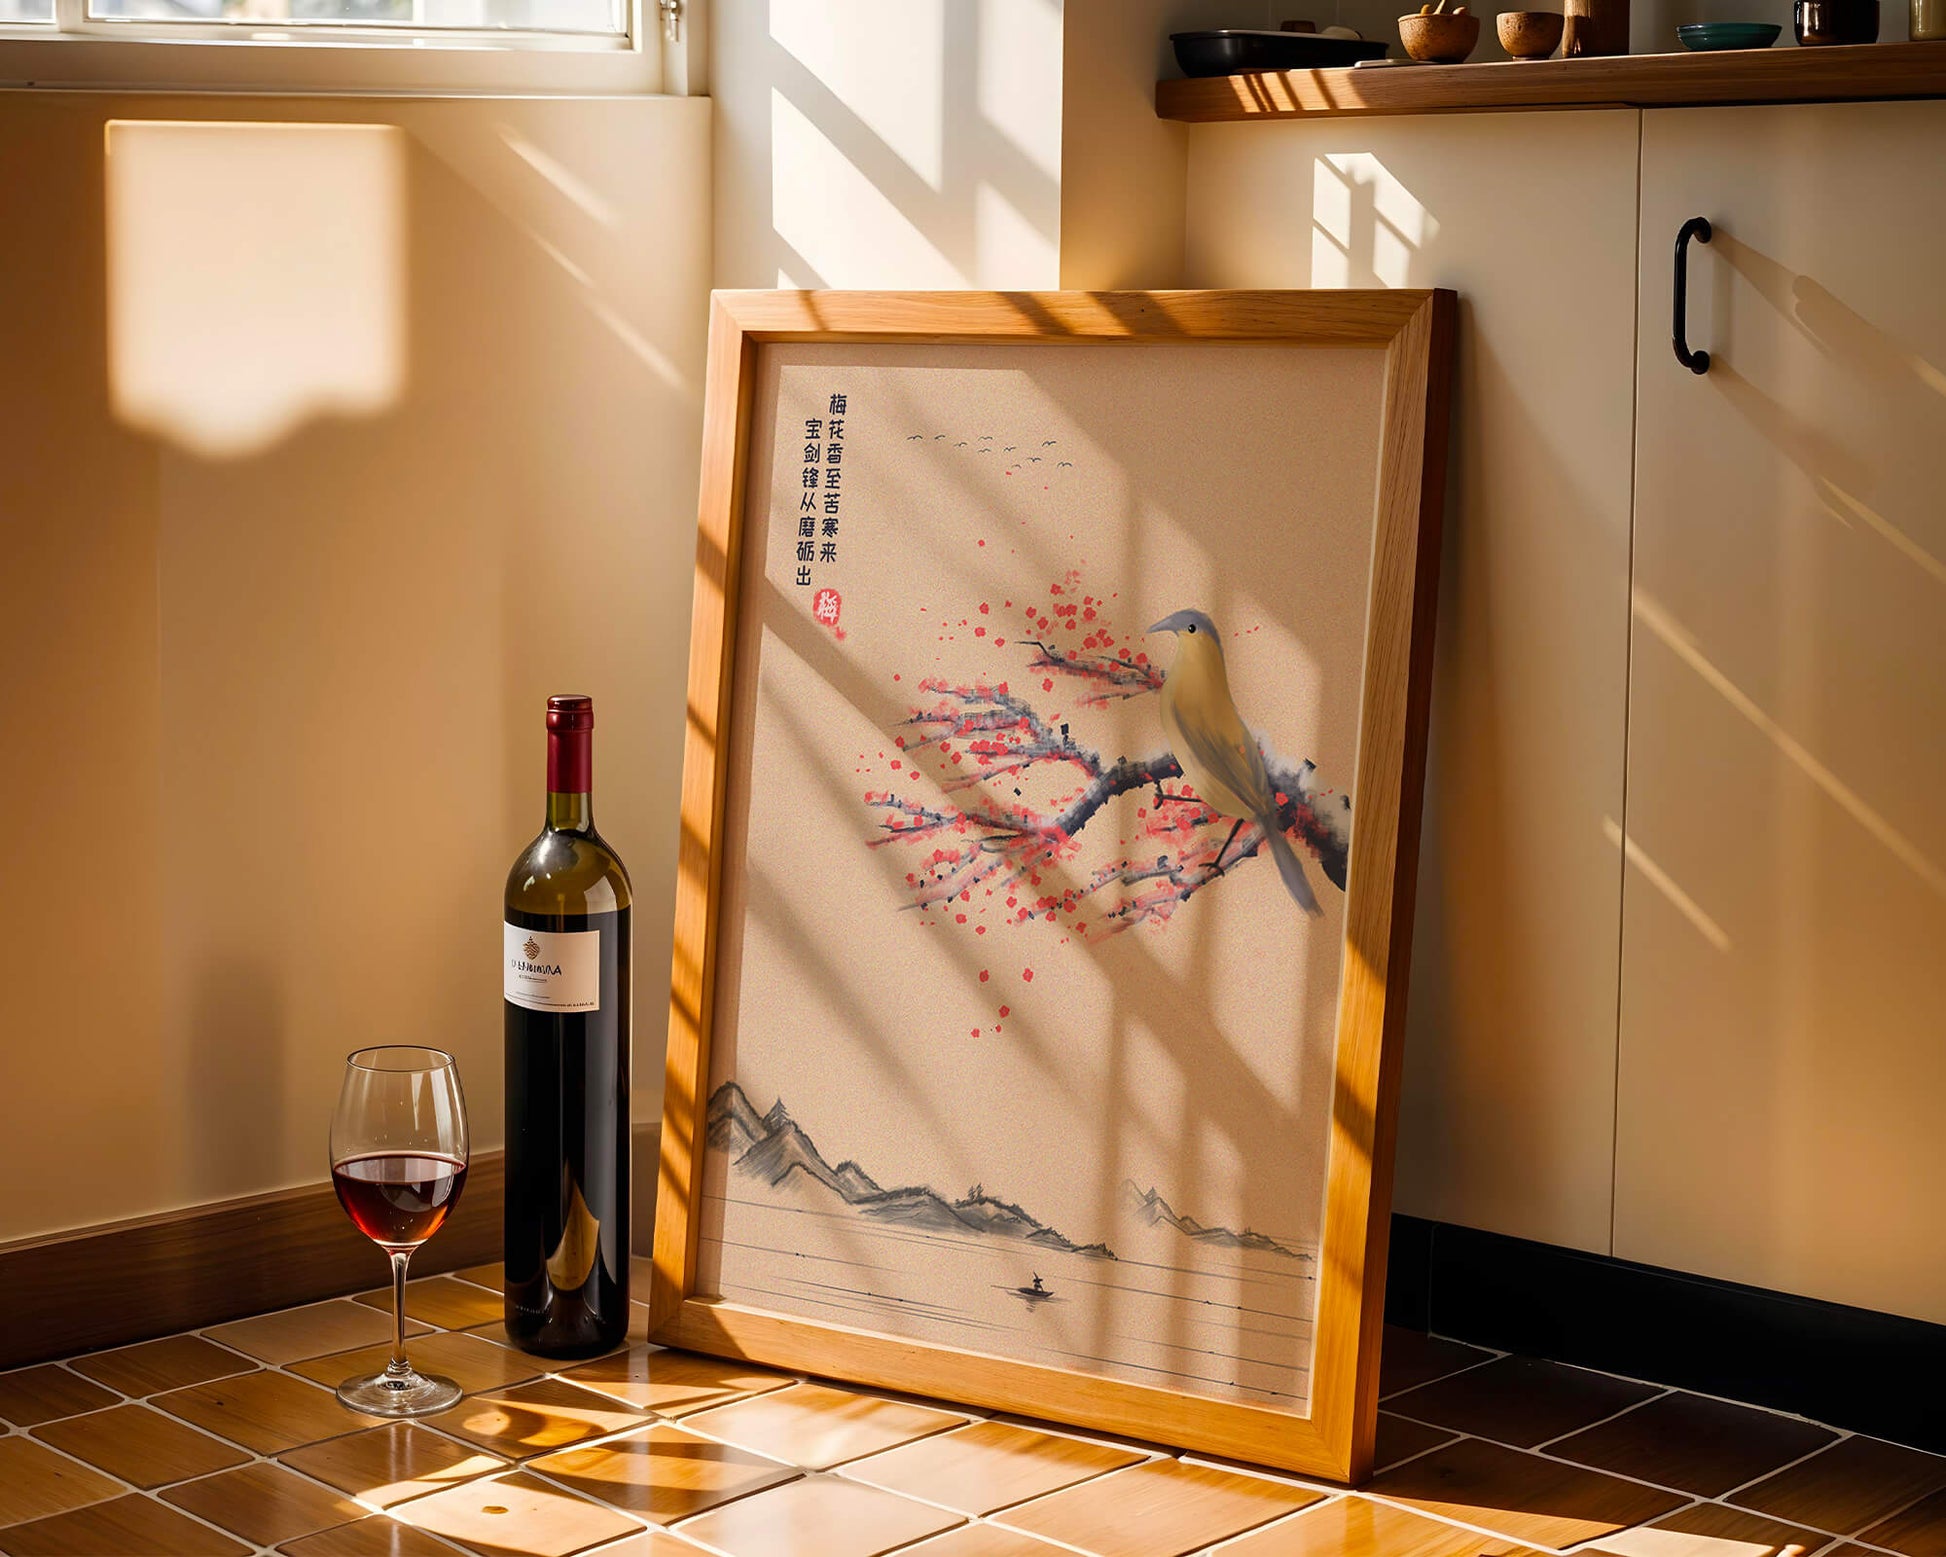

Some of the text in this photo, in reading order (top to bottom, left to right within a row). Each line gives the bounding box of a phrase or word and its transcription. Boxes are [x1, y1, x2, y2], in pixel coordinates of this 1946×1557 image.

[796, 418, 822, 586] 宝剑锋从磨砺出
[820, 393, 847, 563] 梅花香至苦寒来
